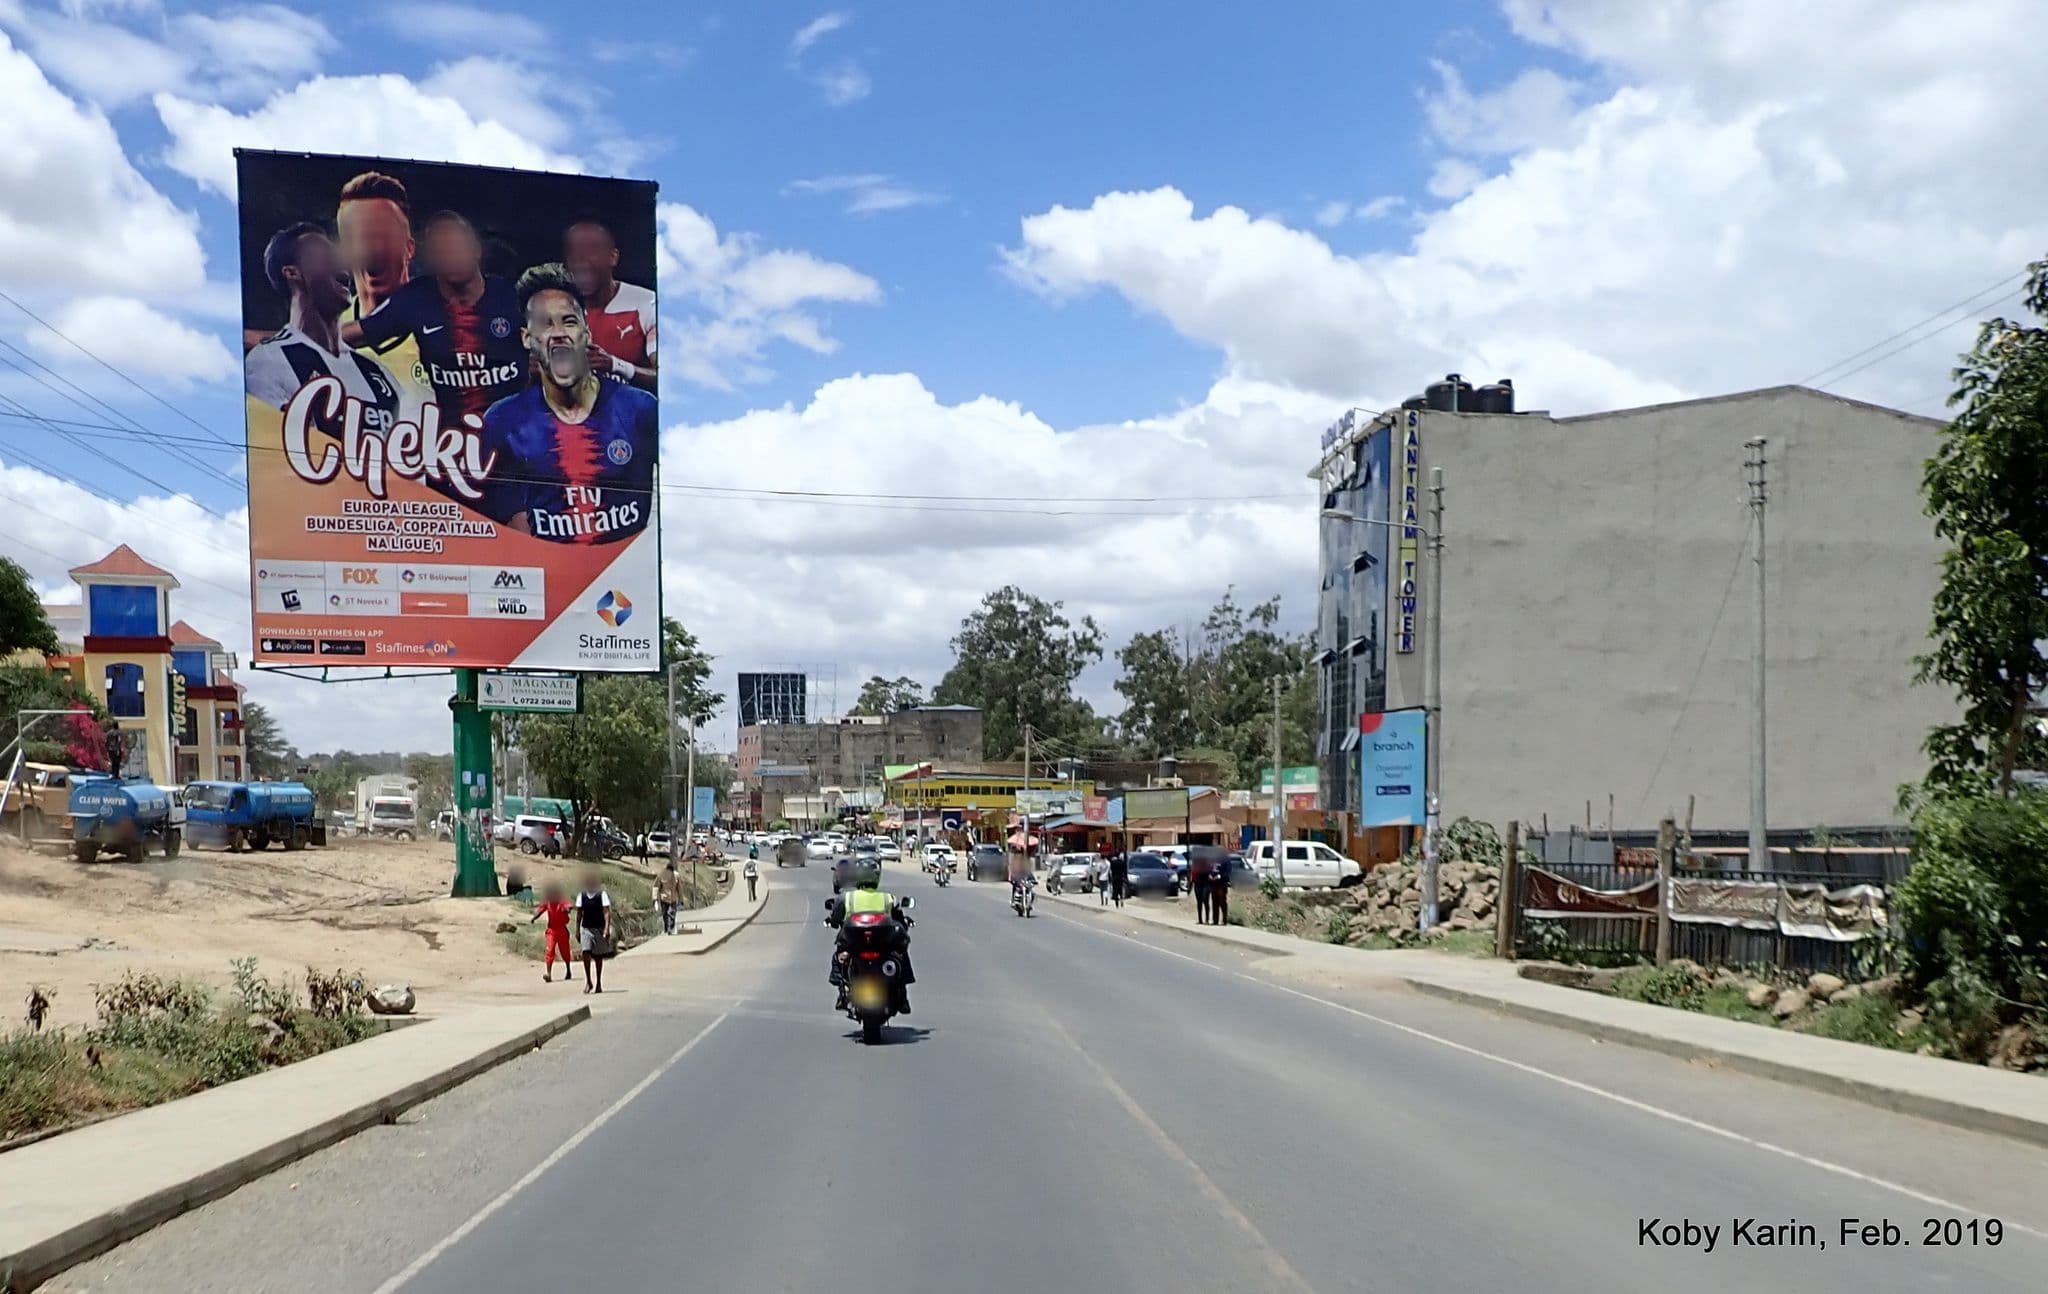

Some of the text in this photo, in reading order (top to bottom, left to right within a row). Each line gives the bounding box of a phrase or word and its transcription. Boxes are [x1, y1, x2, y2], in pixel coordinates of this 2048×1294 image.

[456, 352, 486, 368] Fly
[431, 361, 519, 387] Emirates
[282, 374, 497, 499] Cheki
[566, 487, 602, 506] Fly
[343, 501, 462, 519] EUROPA LEAGUE,
[306, 517, 495, 536] BUNDESLIGA, COPPA ITALIA
[533, 501, 640, 537] Emirates
[1402, 411, 1418, 651] SANTRAM TOWER
[367, 537, 443, 551] NA LIGUE 1
[342, 567, 380, 585] FOX
[498, 604, 527, 615] WILD
[260, 627, 384, 638] DOWNLOAD STARTIMES ON APP
[276, 642, 291, 652] App
[375, 642, 425, 654] StarTimes
[433, 643, 448, 654] ON
[579, 634, 651, 650] StarTimes
[579, 652, 602, 660] ENJOY
[604, 652, 633, 660] DIGITAL
[511, 679, 574, 690] MAGNATE
[171, 673, 187, 735] TUSKYS
[520, 697, 539, 705] 0722
[1374, 741, 1415, 752] branch
